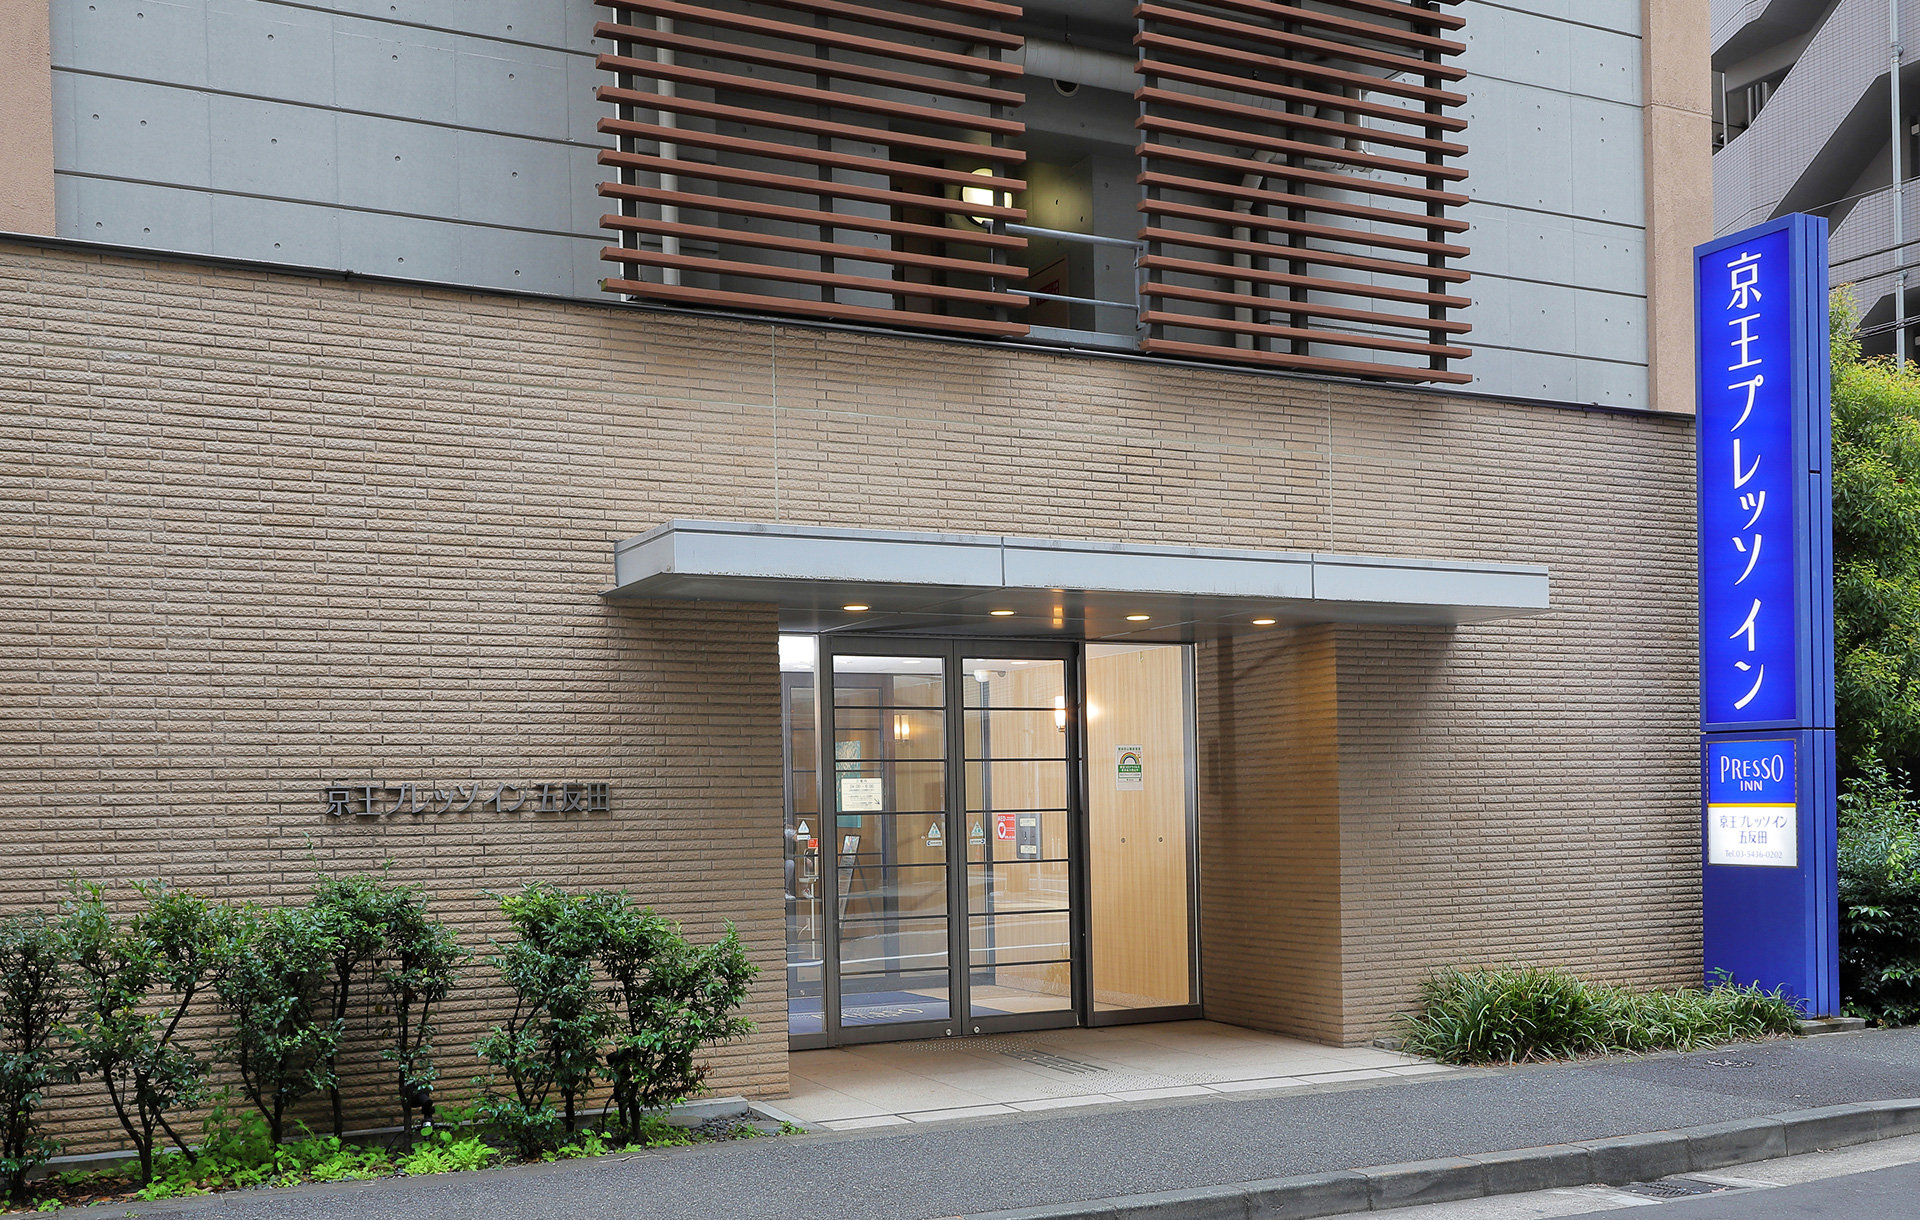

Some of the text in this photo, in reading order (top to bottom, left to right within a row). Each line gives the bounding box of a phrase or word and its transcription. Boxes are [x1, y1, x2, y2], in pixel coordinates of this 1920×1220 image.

[1726, 252, 1766, 711] 京王プレッソイン
[1720, 754, 1784, 783] PRESSO
[1740, 780, 1763, 791] INN
[1719, 815, 1787, 829] 京王プレッソイン
[1738, 831, 1768, 844] 五反田
